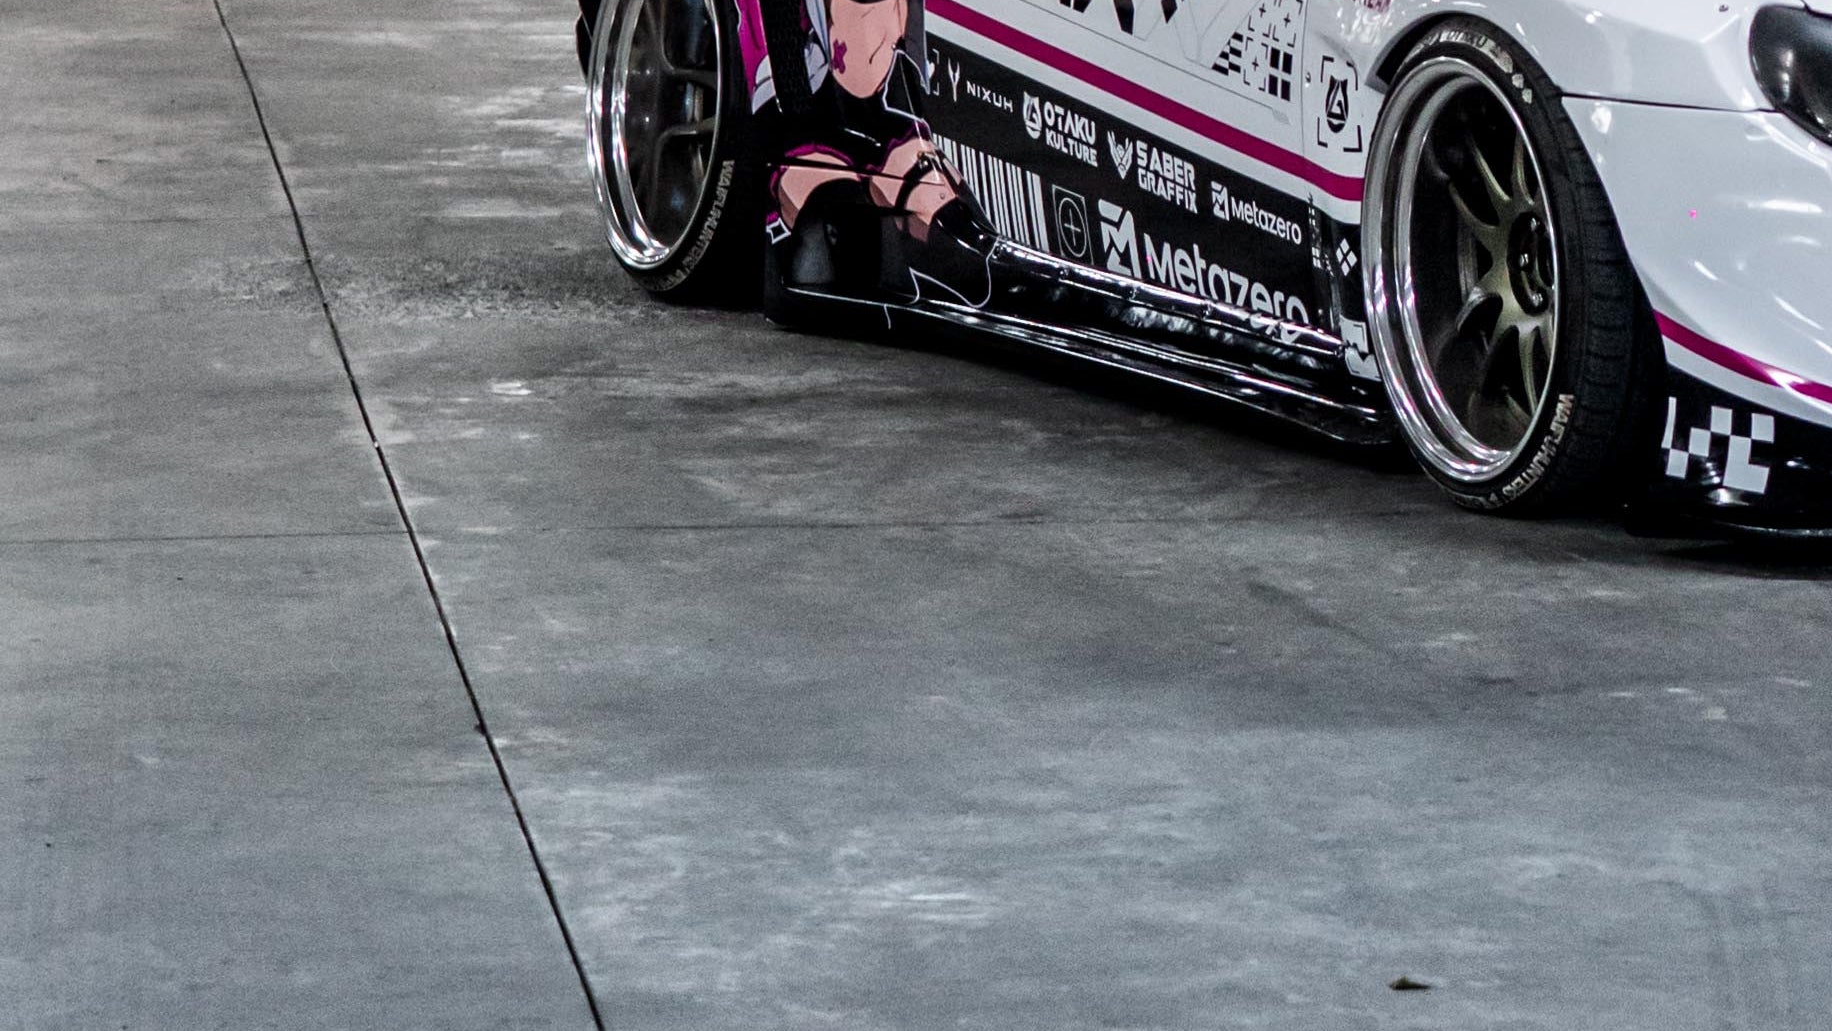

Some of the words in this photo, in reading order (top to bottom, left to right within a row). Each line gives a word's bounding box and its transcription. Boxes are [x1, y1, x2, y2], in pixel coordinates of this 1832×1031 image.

[966, 80, 1014, 113] NIXUH
[1043, 100, 1096, 146] OTAKU
[1045, 127, 1098, 168] KULTURE
[1135, 139, 1196, 191] SABER
[1137, 167, 1198, 215] GRAFFIX
[1231, 196, 1302, 245] Metazero
